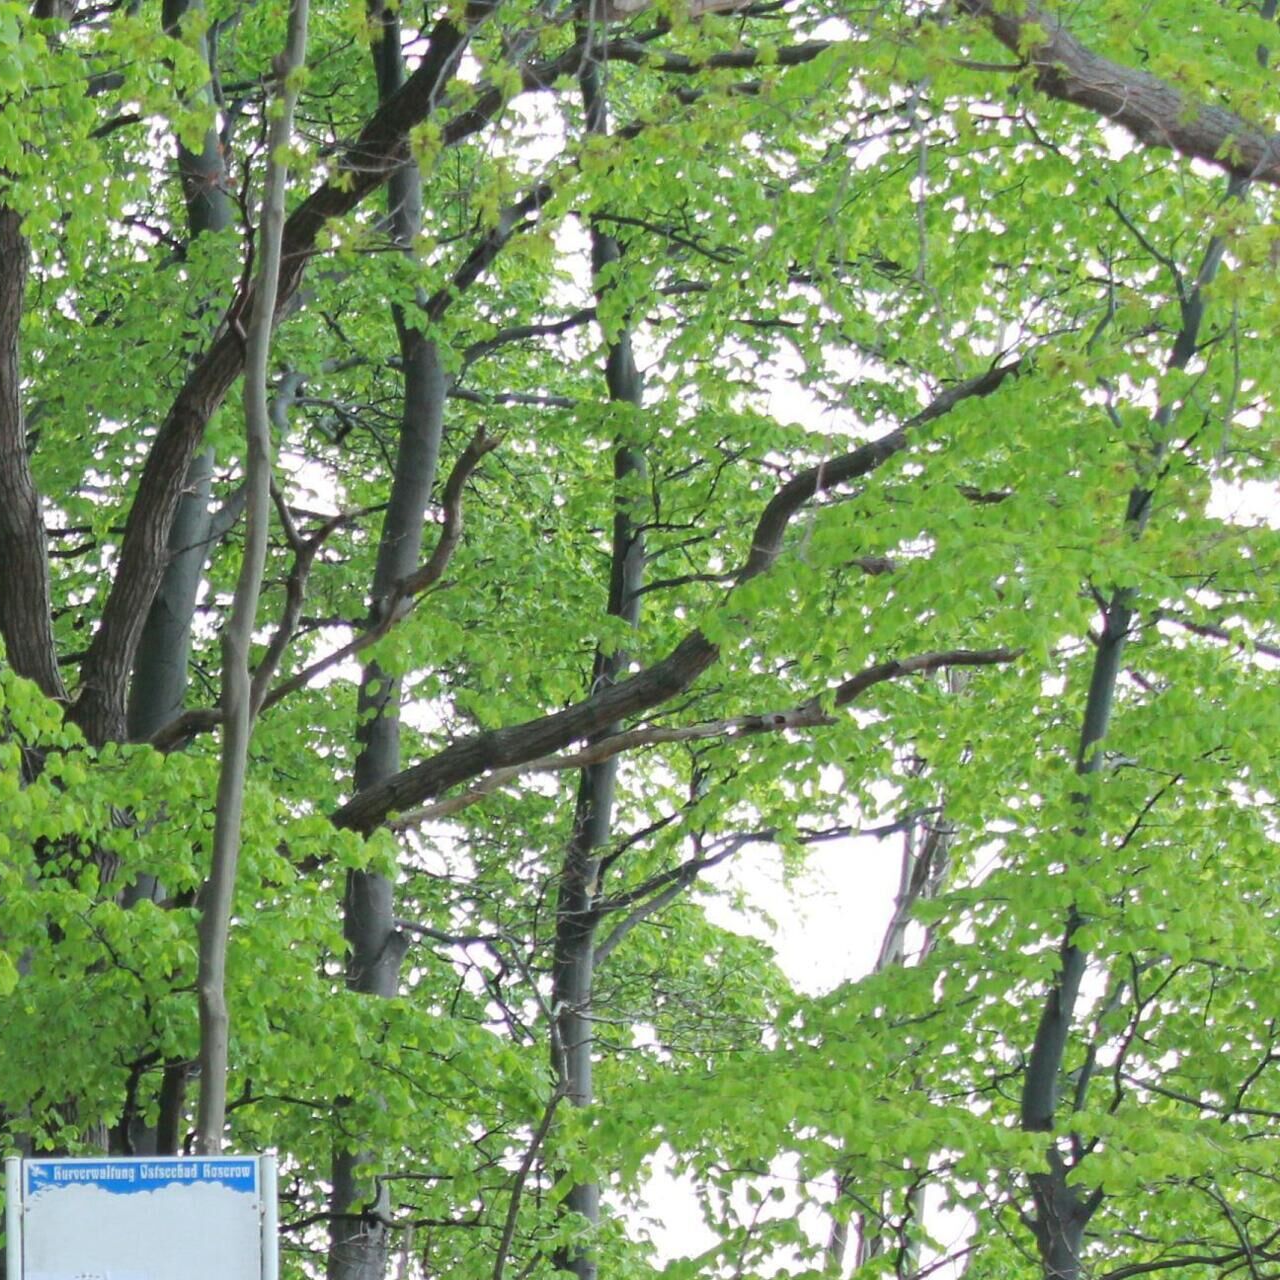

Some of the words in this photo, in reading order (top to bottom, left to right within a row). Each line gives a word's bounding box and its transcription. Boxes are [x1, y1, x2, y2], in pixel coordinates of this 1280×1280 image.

[53, 1165, 135, 1182] Kurverwaltung
[140, 1164, 198, 1179] Ostseebad
[202, 1163, 251, 1178] Koserow
